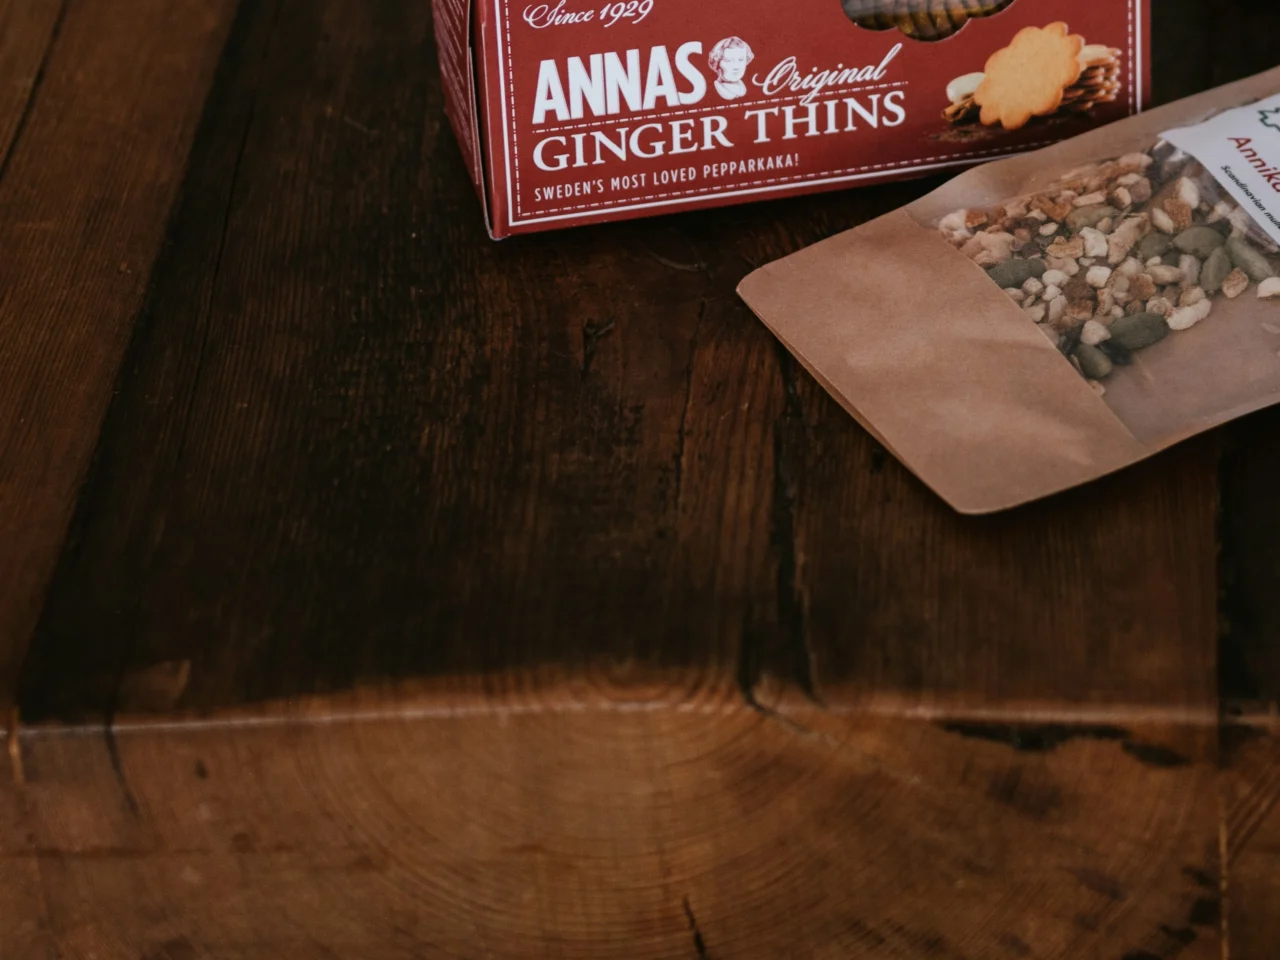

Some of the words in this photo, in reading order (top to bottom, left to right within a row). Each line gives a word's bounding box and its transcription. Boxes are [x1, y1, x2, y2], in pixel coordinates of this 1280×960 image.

[532, 41, 707, 125] ANNAS
[752, 43, 902, 106] Original
[533, 116, 733, 172] GINGER
[745, 90, 907, 144] THINS
[534, 179, 604, 202] SWEDEN'S
[611, 174, 646, 192] MOST
[653, 168, 697, 187] LOVED
[703, 153, 800, 179] PEPPARKAKA!
[1221, 165, 1266, 212] Scandinavian
